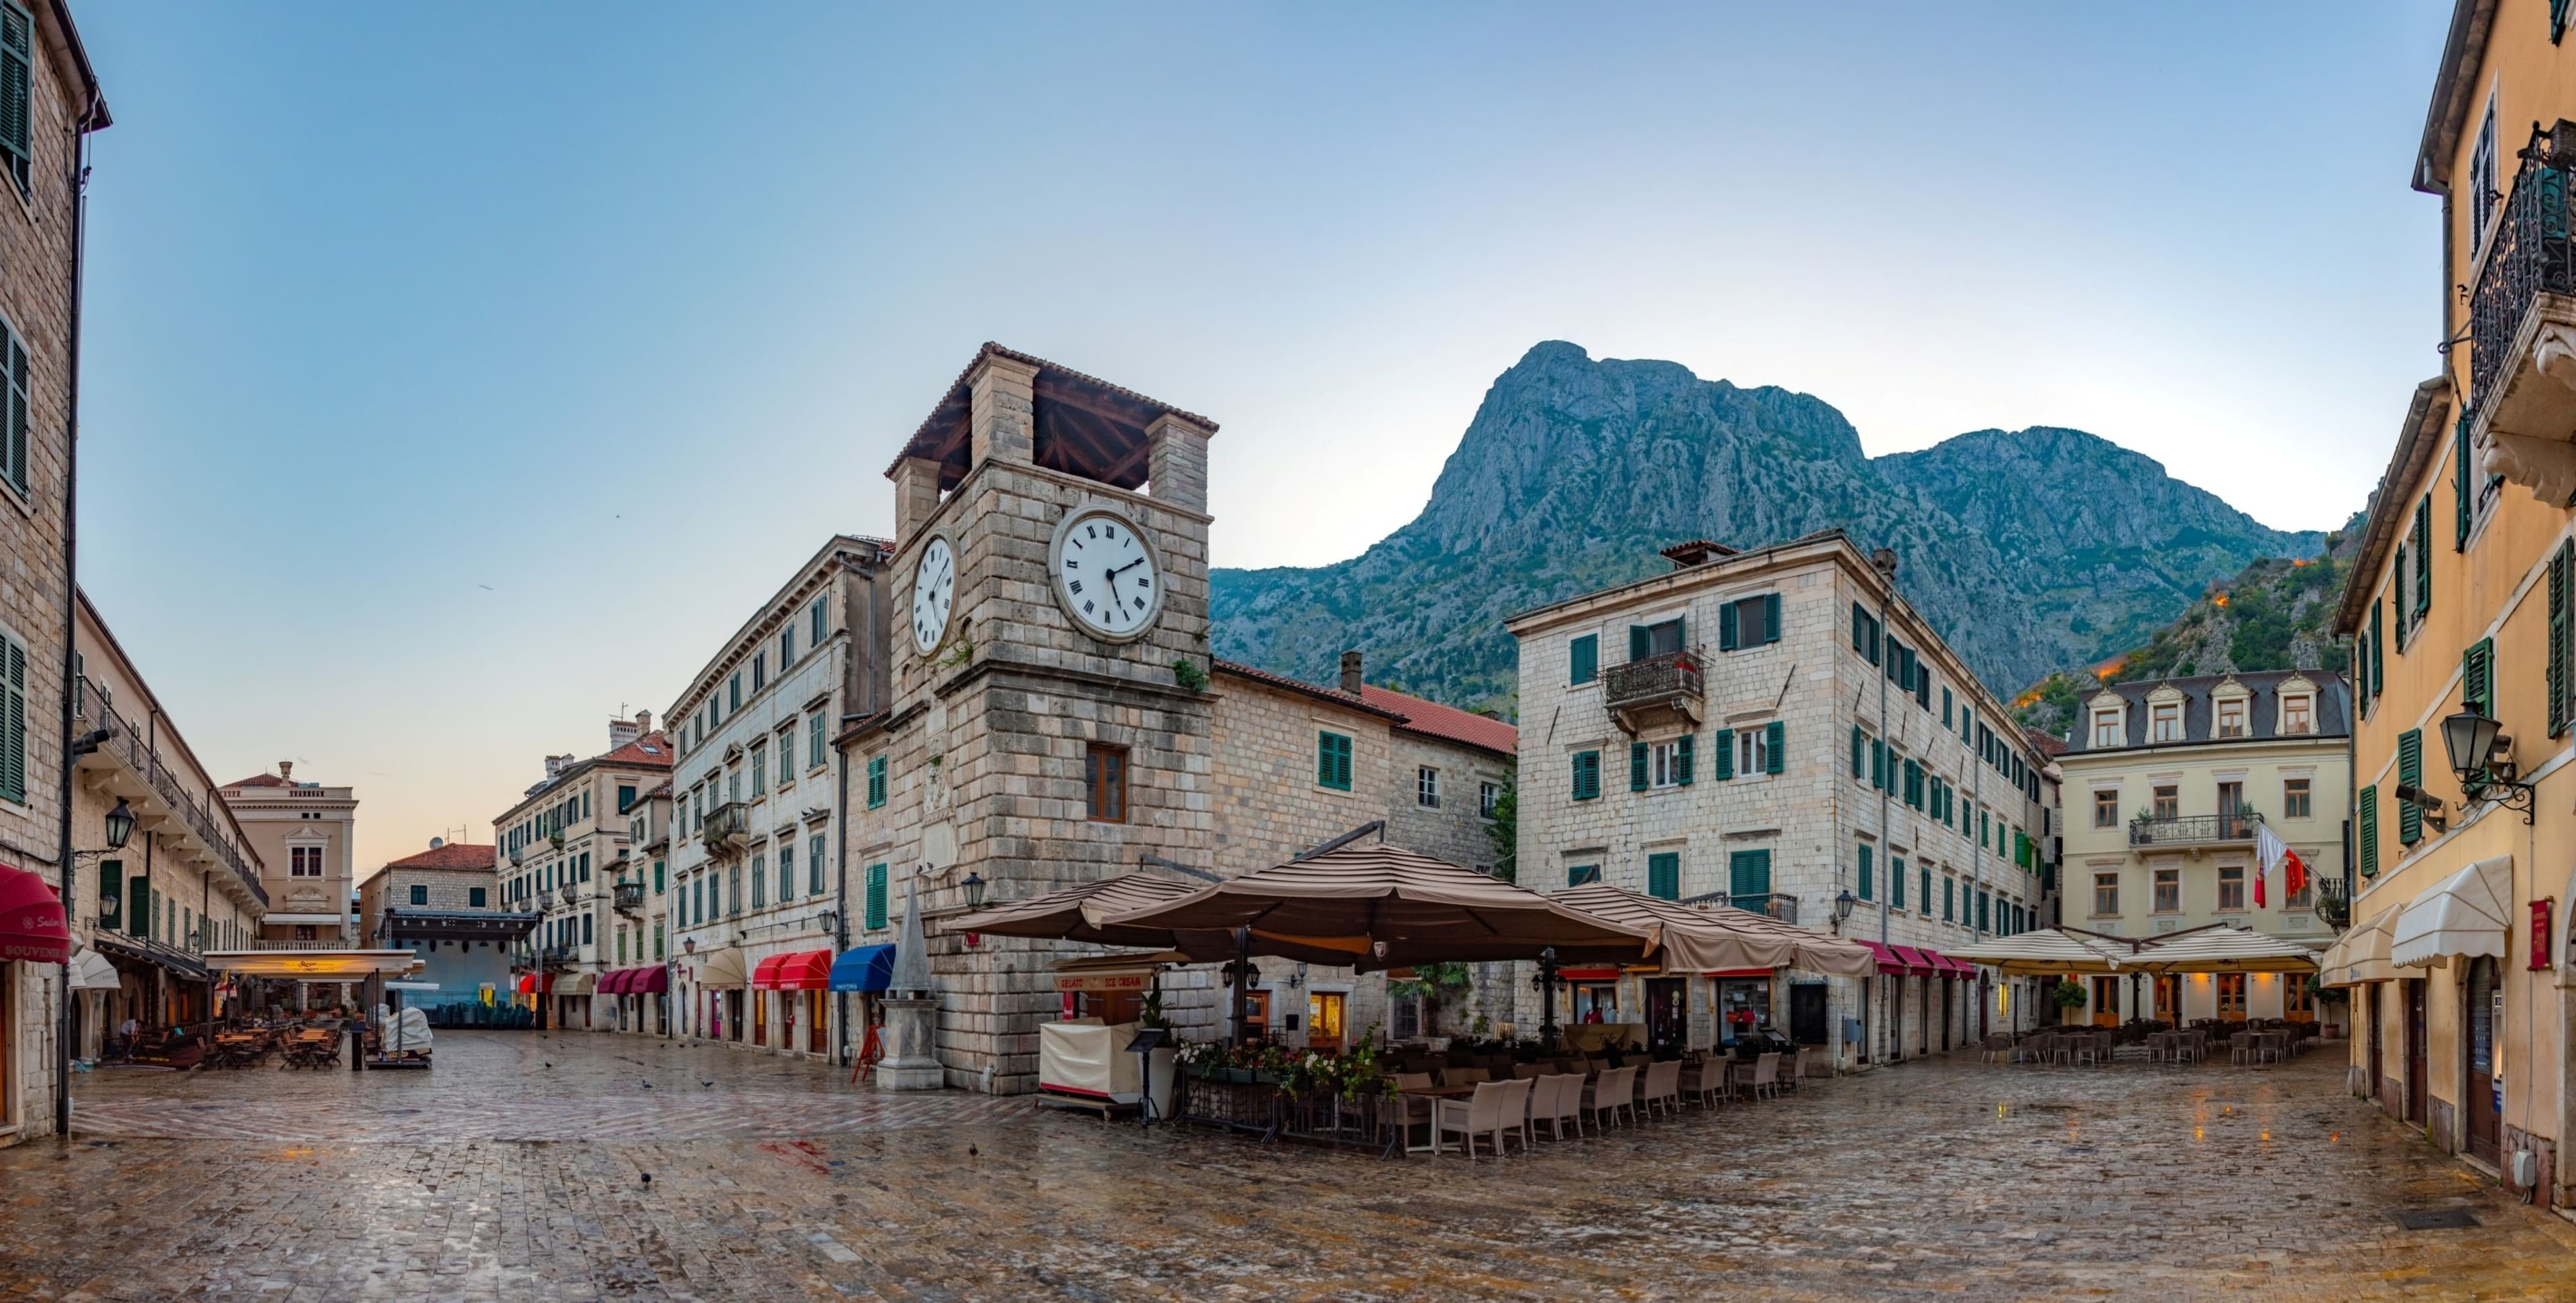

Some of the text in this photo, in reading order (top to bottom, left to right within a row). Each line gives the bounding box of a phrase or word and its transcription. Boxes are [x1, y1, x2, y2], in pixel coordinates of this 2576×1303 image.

[1106, 525, 1114, 539] XII
[1138, 578, 1149, 587] III
[1061, 978, 1083, 988] GELATO
[1105, 976, 1141, 988] ICE CREAM
